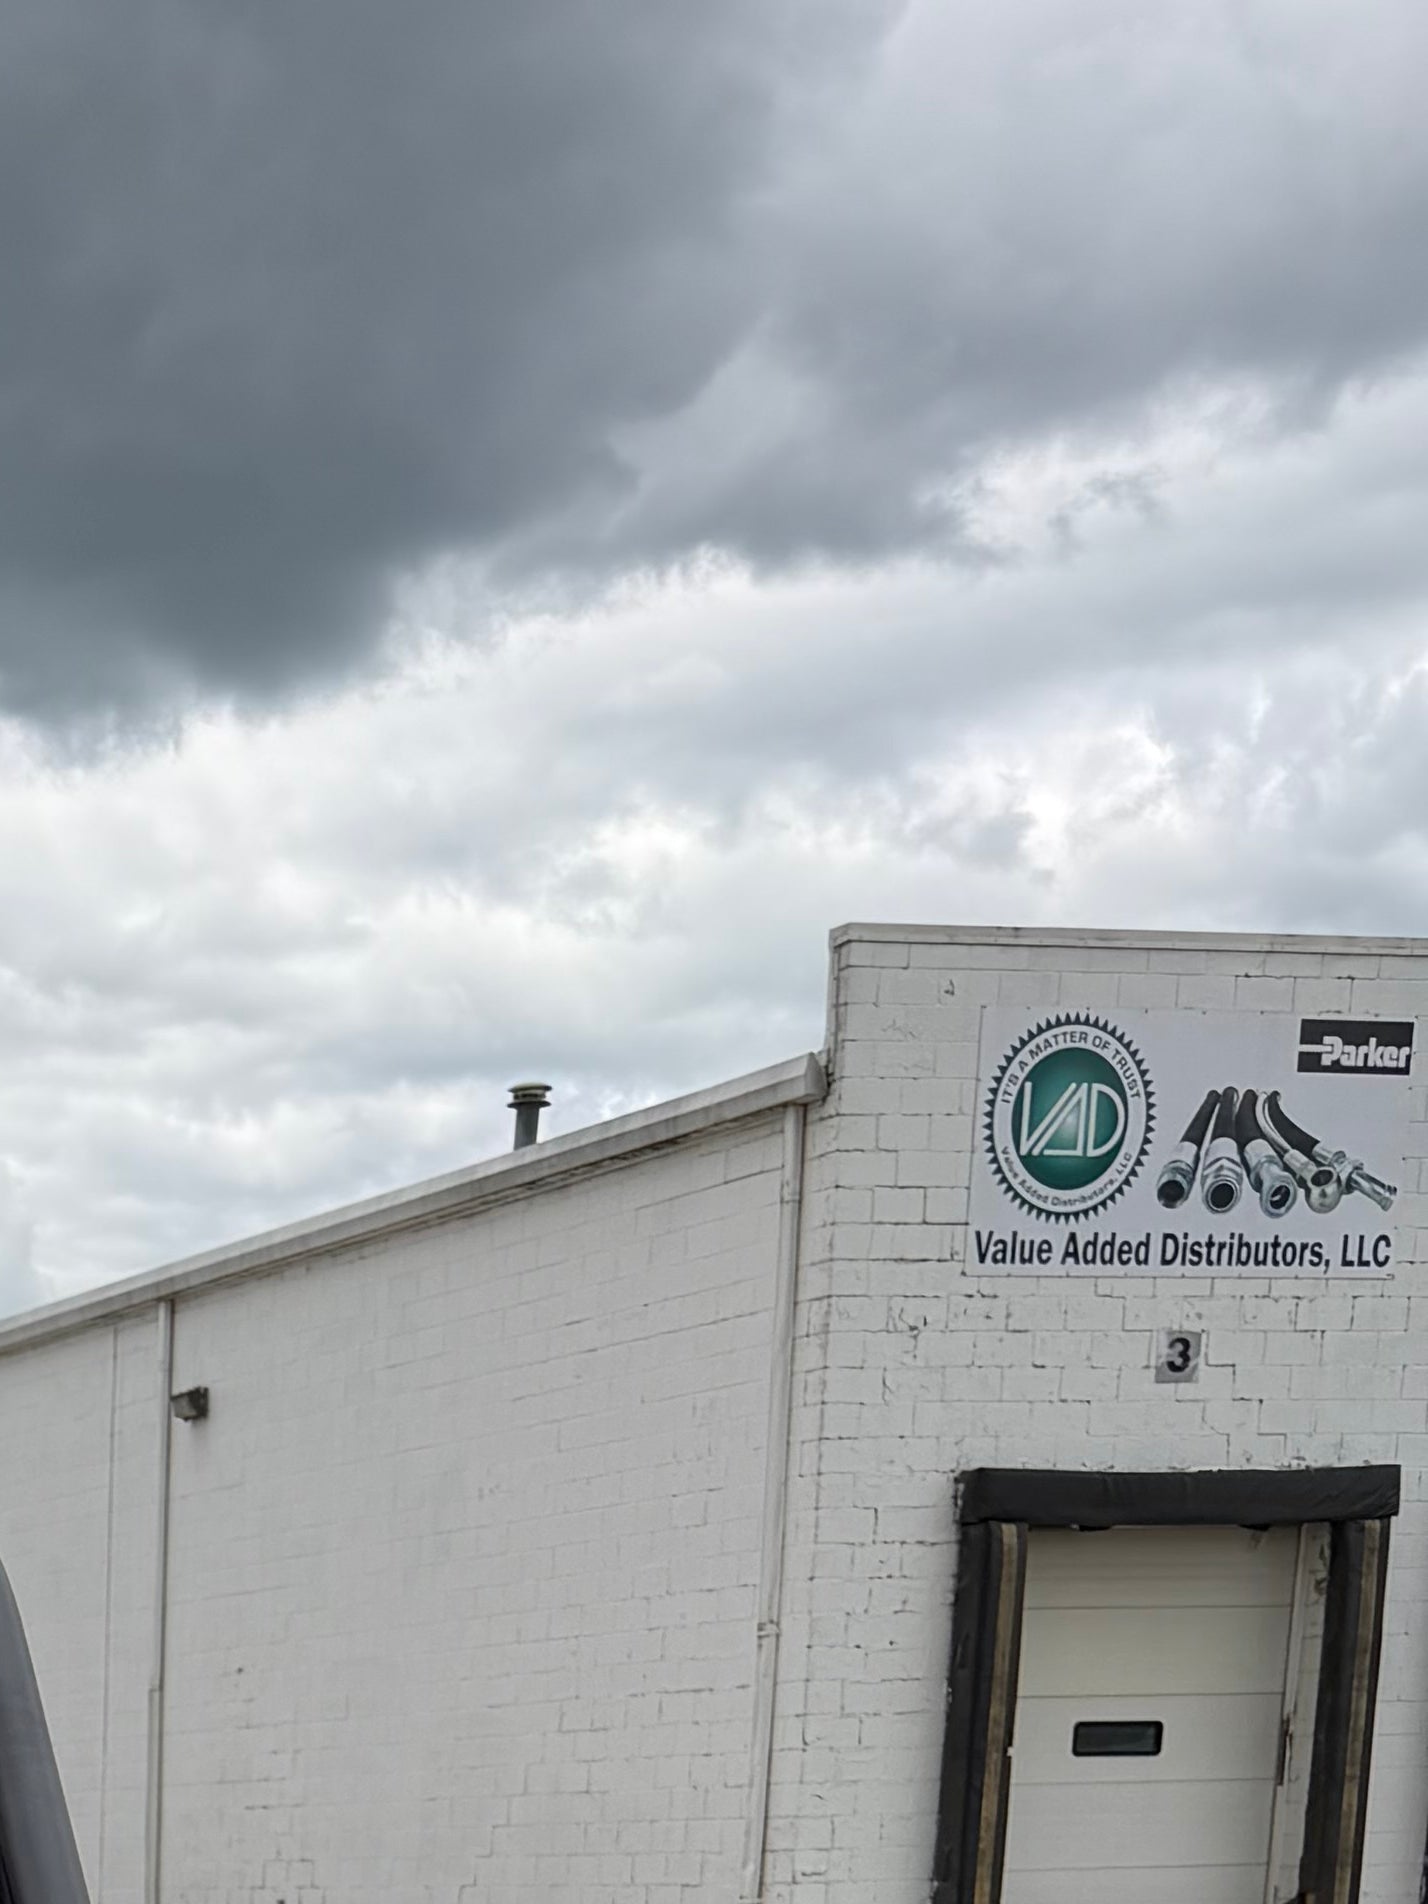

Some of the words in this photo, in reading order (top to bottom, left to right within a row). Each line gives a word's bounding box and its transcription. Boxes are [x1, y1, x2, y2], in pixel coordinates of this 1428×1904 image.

[1018, 1060, 1029, 1073] A
[1030, 1030, 1088, 1062] MATTER
[1093, 1035, 1111, 1051] OF
[1110, 1048, 1141, 1100] TRUST
[1320, 1035, 1410, 1069] Parker
[975, 1230, 1053, 1265] Value
[1060, 1231, 1151, 1267] Added
[1160, 1233, 1331, 1275] Distributors,
[1341, 1234, 1393, 1268] LLC
[1165, 1336, 1191, 1373] 3
